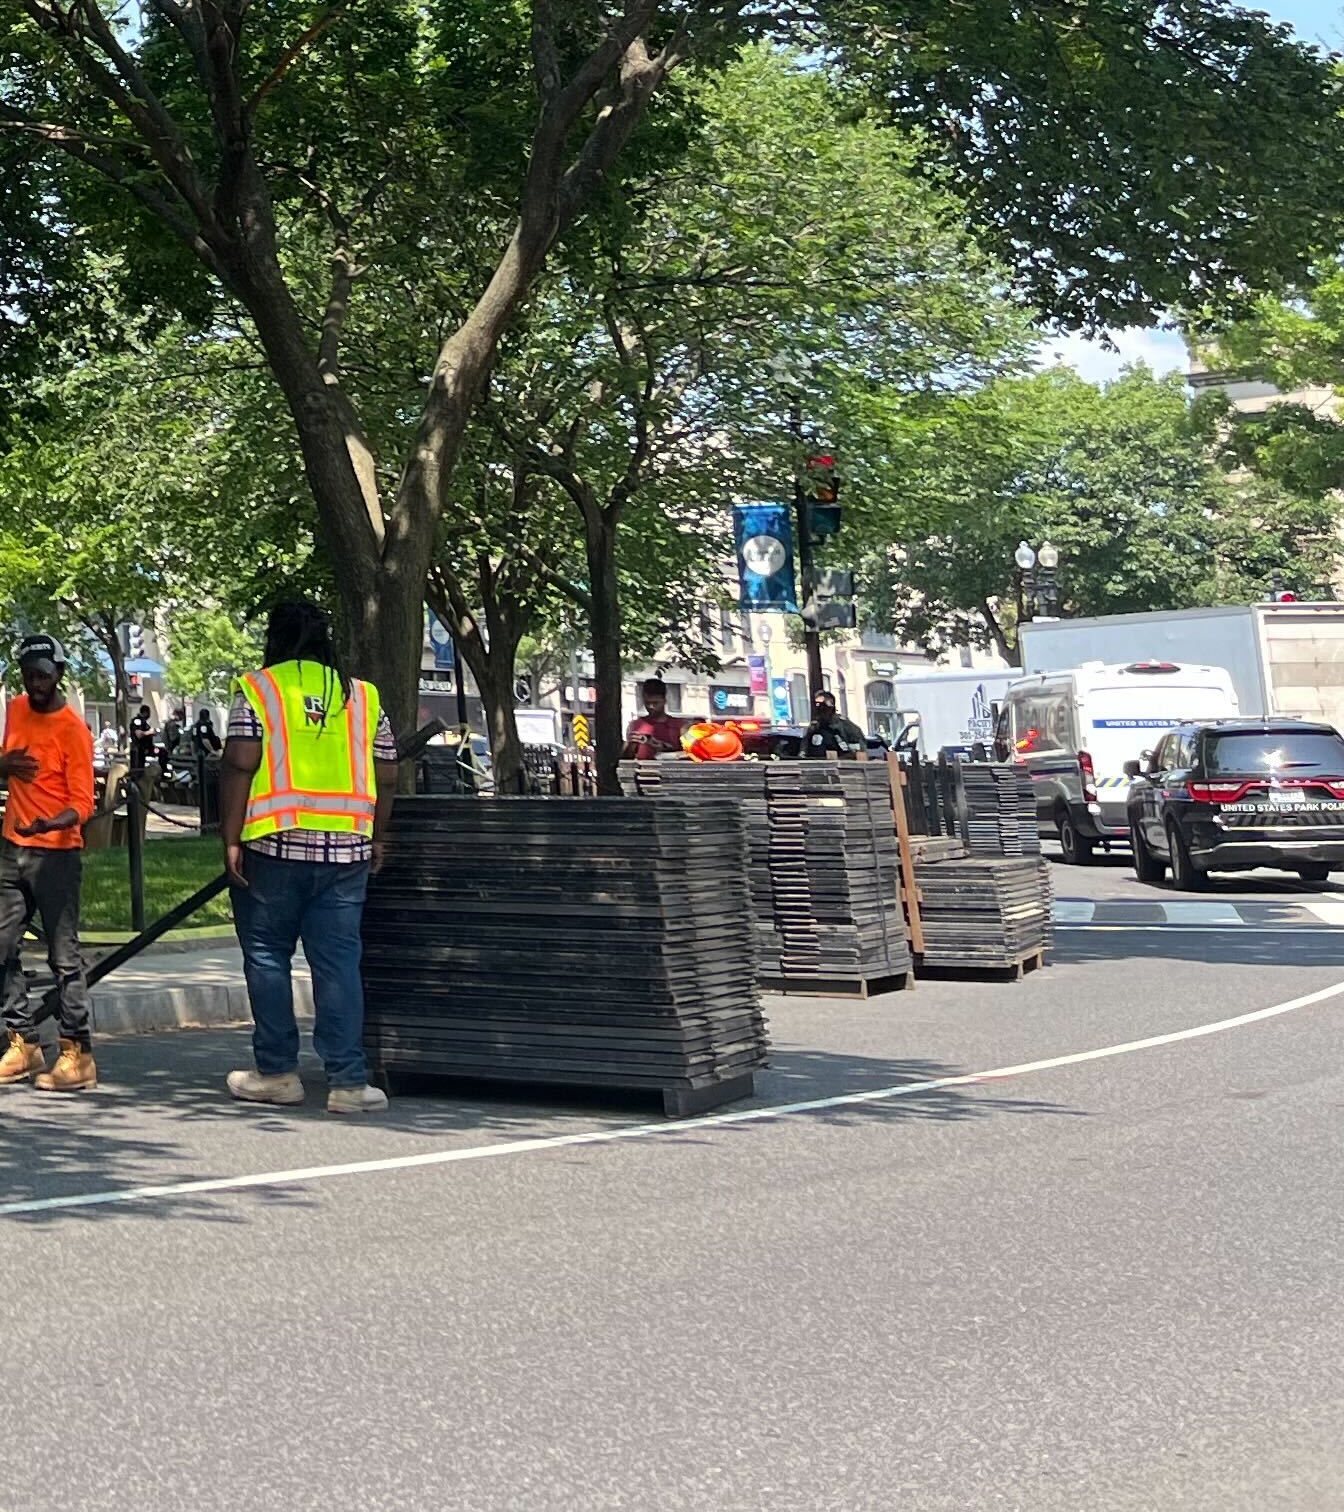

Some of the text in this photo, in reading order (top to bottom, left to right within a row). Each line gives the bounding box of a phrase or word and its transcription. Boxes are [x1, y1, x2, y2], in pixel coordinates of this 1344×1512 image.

[1220, 802, 1344, 813] UNITED STATES PARK POLI
